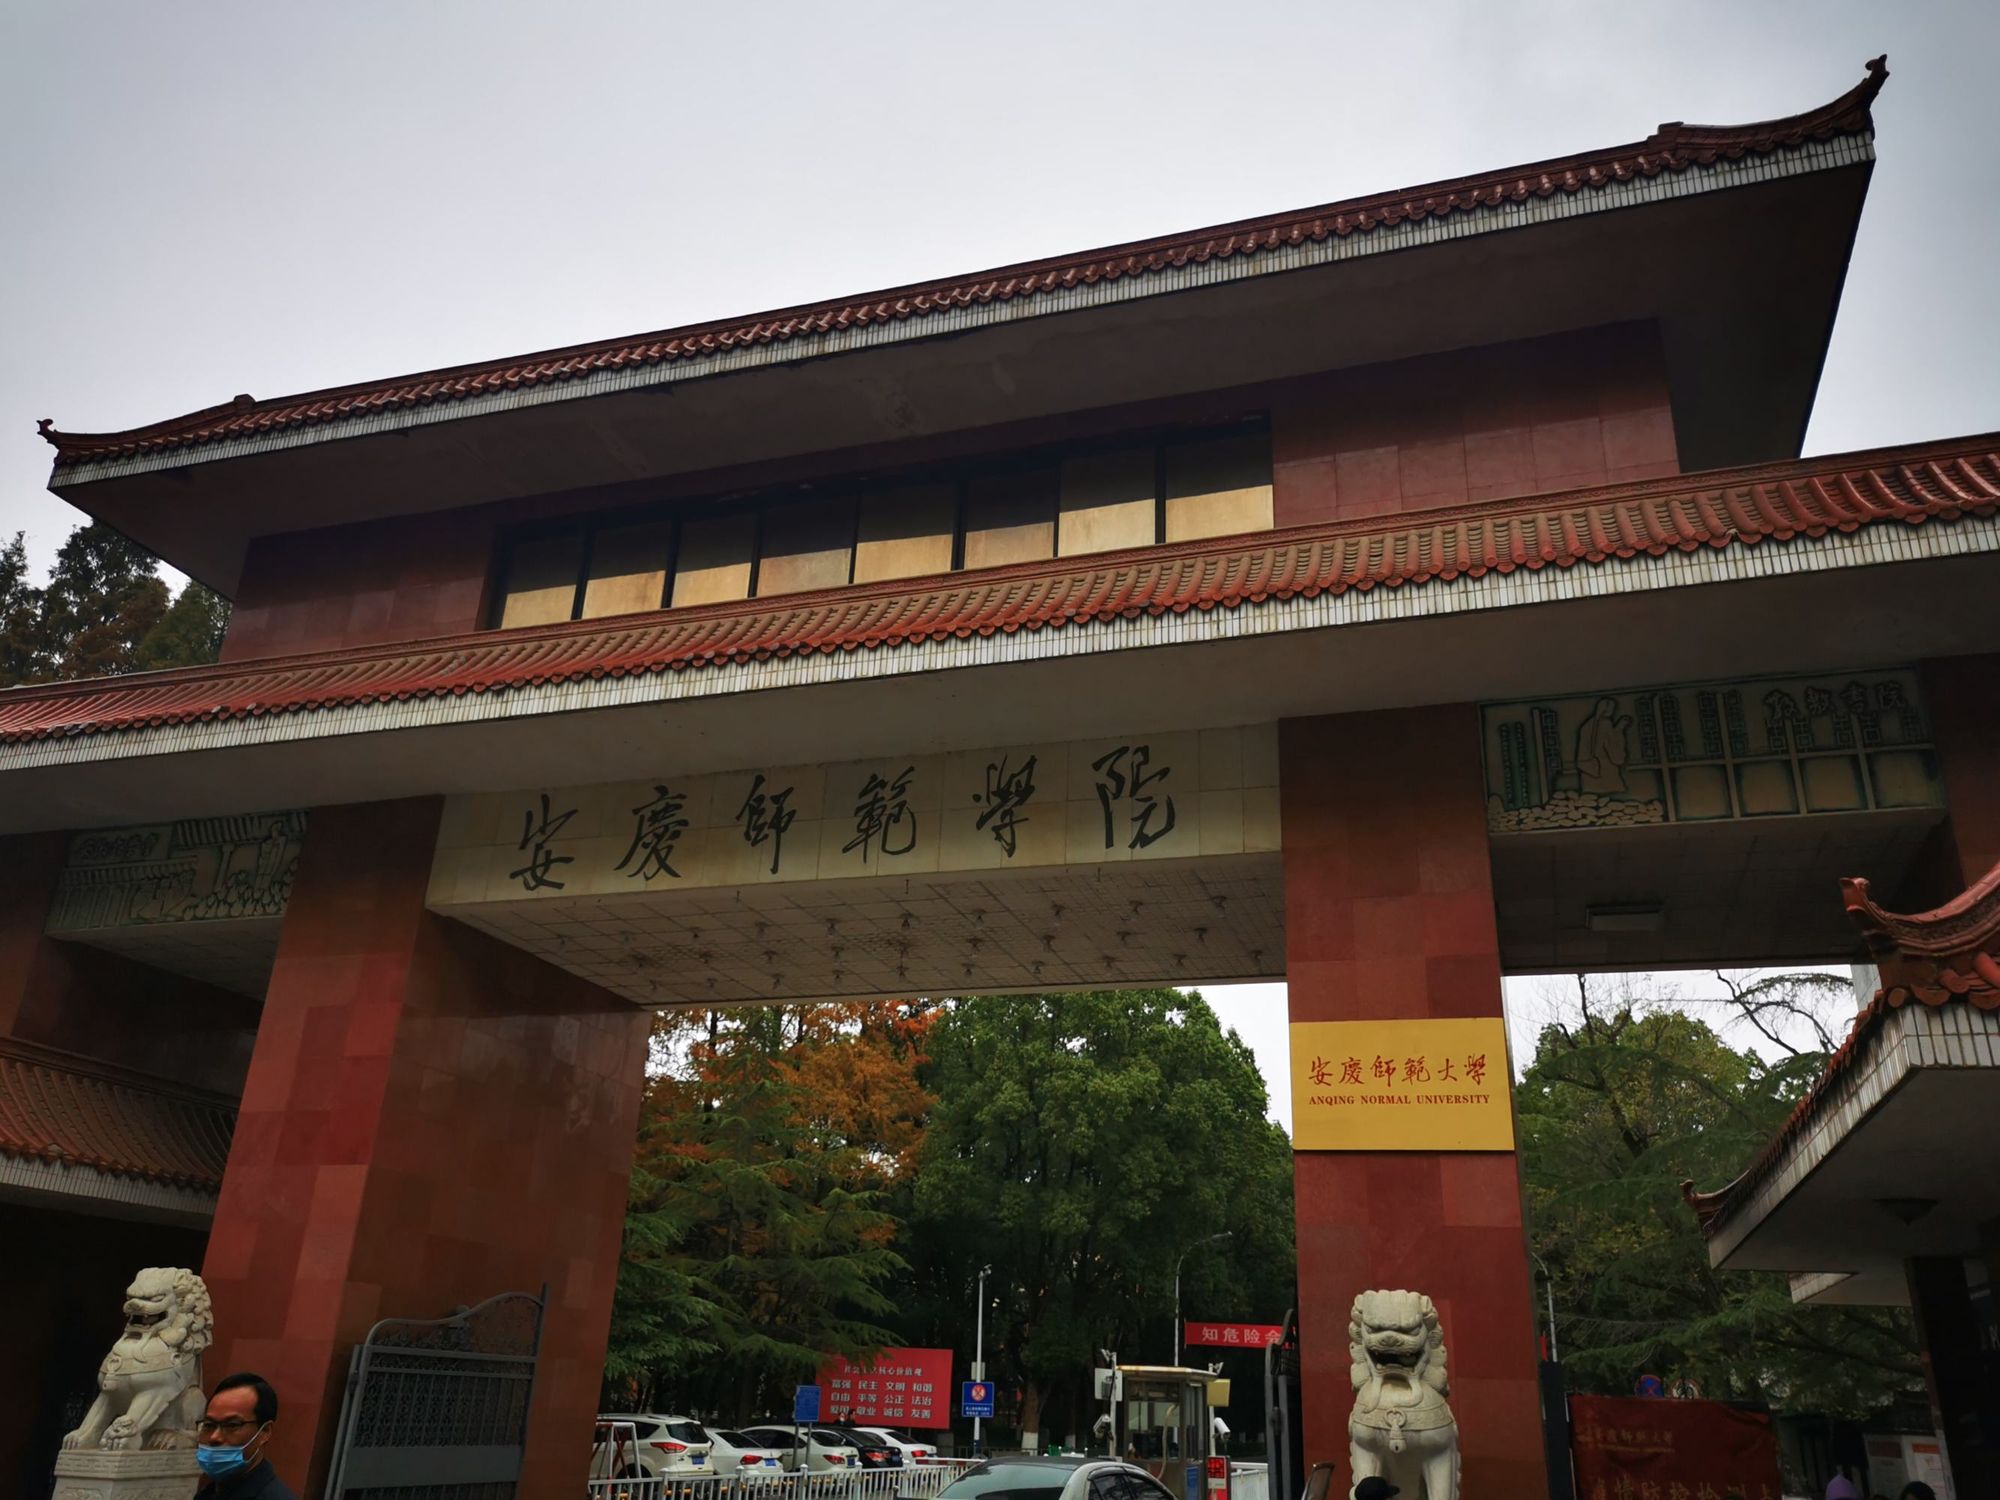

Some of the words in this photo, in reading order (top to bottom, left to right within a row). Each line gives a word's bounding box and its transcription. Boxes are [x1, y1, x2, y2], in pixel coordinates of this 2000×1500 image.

[1309, 1095, 1355, 1106] ANQING
[1361, 1095, 1411, 1105] NORMAL
[1416, 1094, 1490, 1104] UNIVERSITY
[858, 1380, 878, 1390] 民主
[886, 1382, 905, 1391] 文明
[884, 1395, 905, 1404] 公正
